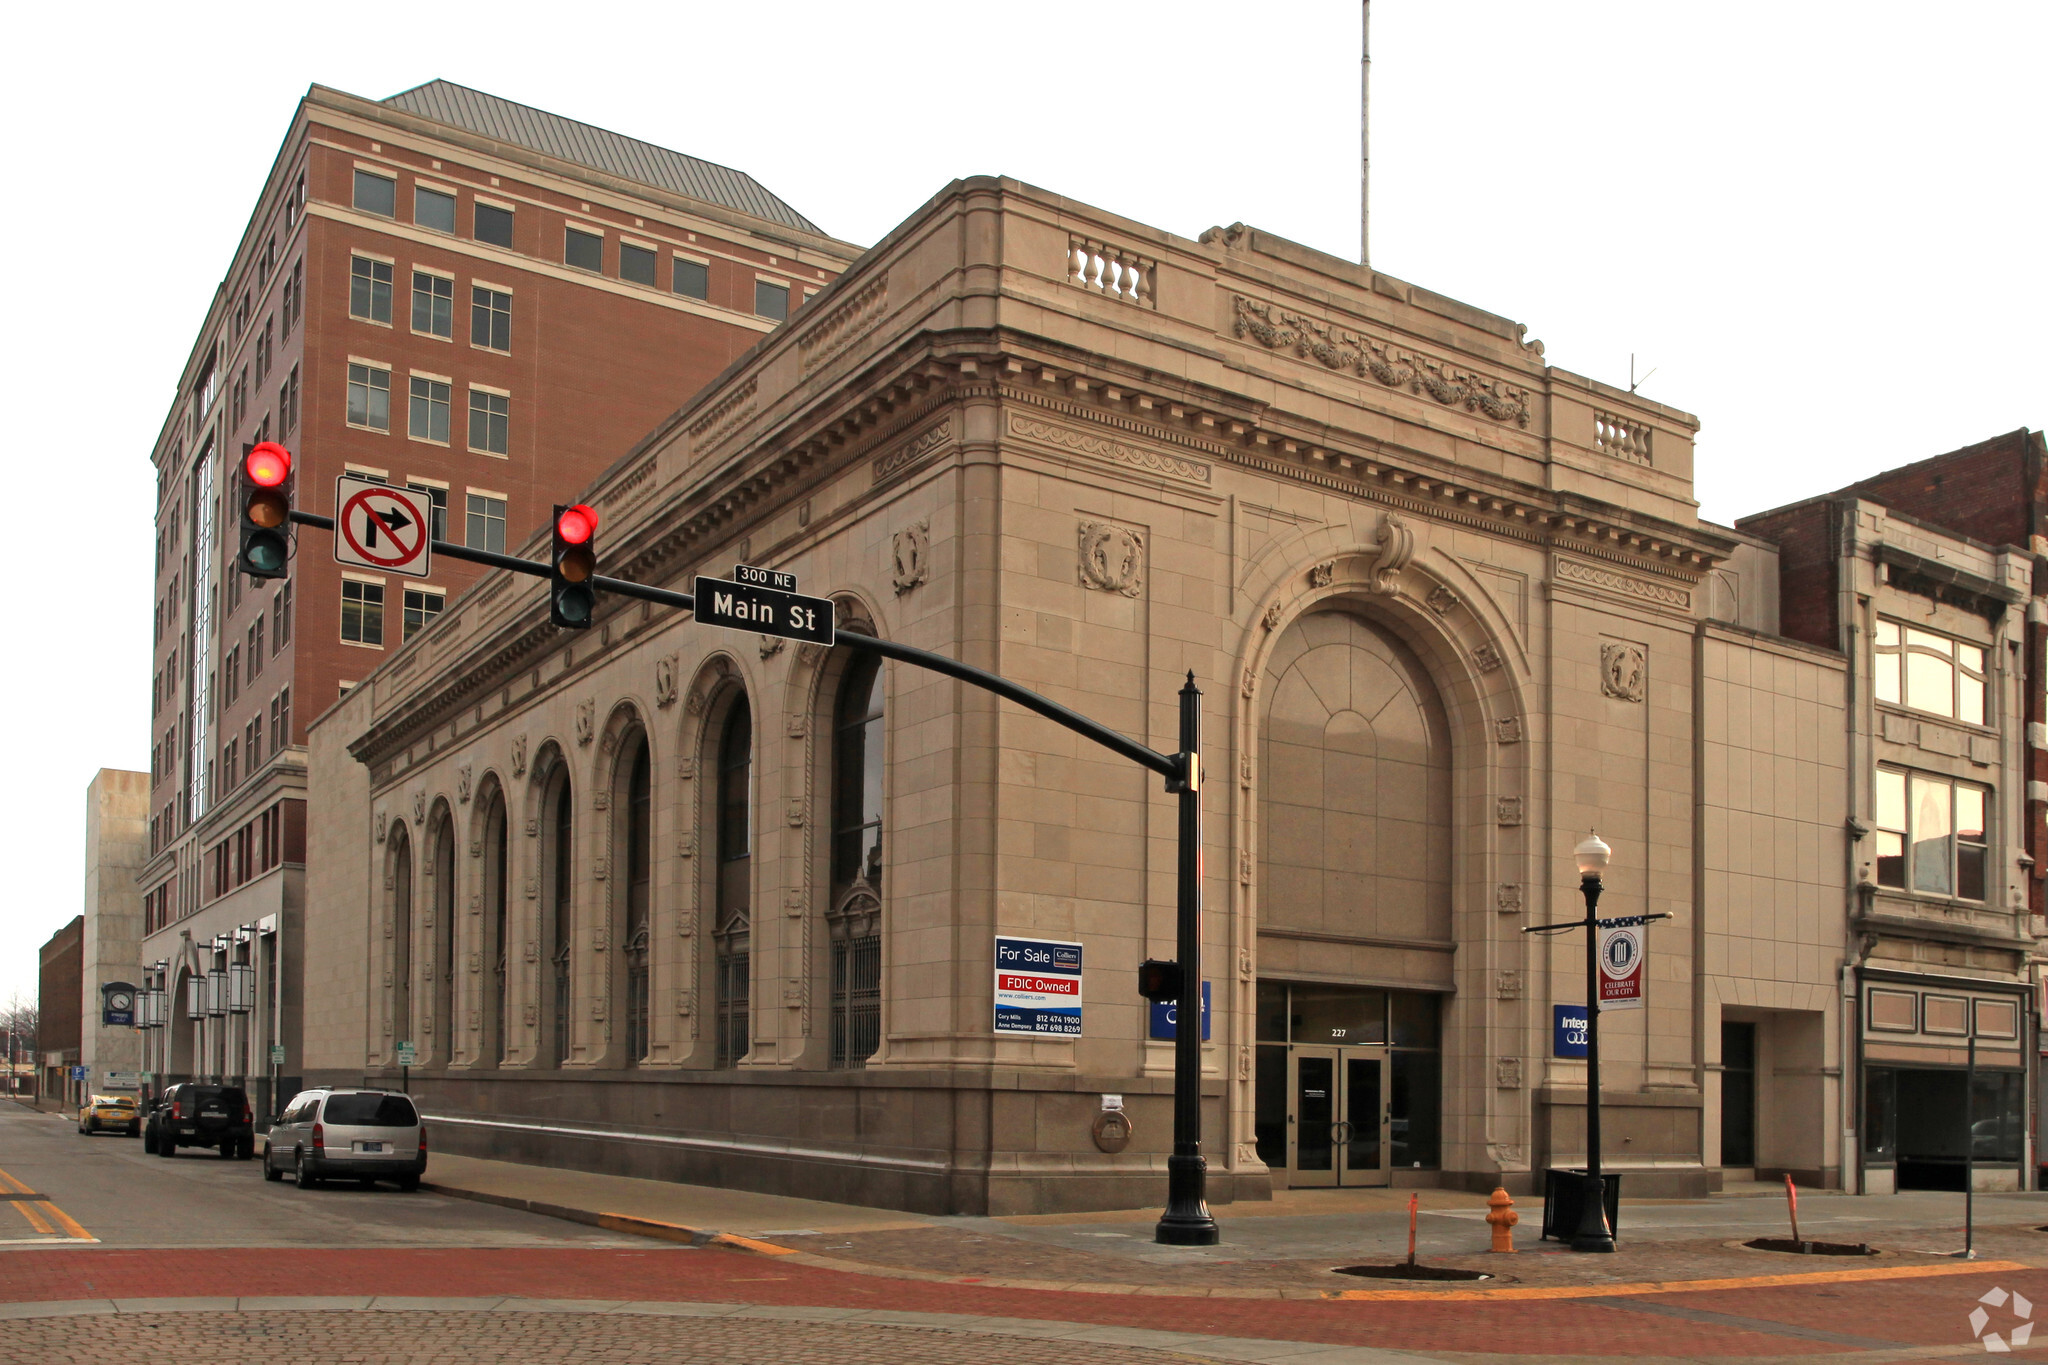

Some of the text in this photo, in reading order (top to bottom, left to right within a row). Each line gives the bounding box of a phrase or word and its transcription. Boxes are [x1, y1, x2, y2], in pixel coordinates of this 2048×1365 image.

[741, 568, 791, 587] 300 NE
[714, 591, 816, 631] Main St
[1000, 946, 1050, 963] For Sale
[1056, 951, 1077, 959] Colliers
[1007, 977, 1070, 992] FDIC Owned
[1604, 980, 1635, 989] CELEBRATE
[1620, 987, 1634, 995] CITY
[1050, 1015, 1062, 1023] 474
[1064, 1016, 1080, 1024] 1900
[1035, 1023, 1048, 1031] 847
[1050, 1024, 1062, 1032] 698
[1064, 1025, 1080, 1033] 8269
[1332, 1028, 1346, 1037] 227
[75, 1067, 82, 1075] P
